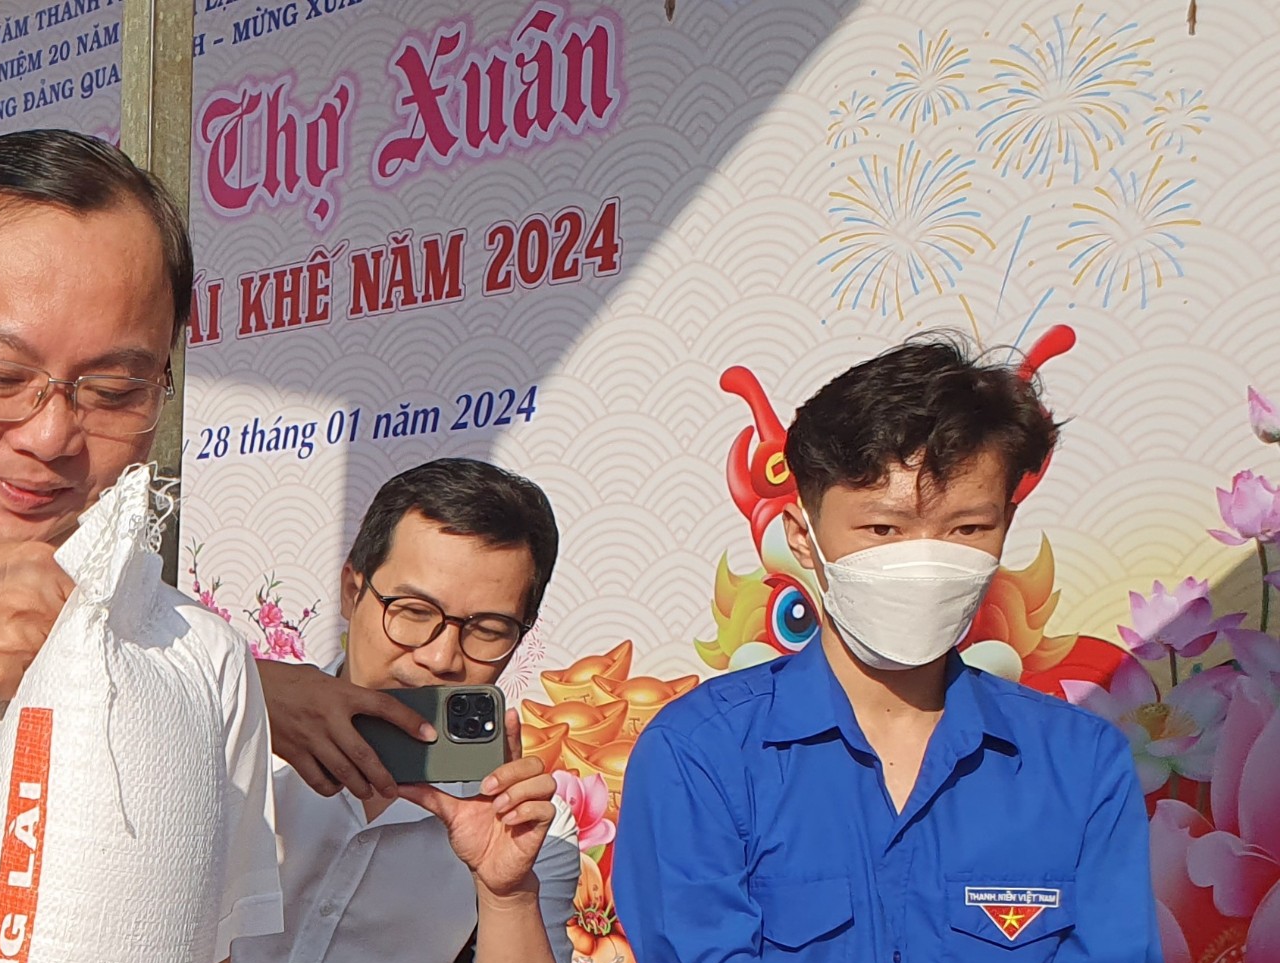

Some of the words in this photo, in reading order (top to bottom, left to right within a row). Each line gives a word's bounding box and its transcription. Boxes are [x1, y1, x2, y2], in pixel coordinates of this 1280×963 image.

[48, 41, 71, 66] 20
[76, 22, 120, 56] NĂM
[232, 3, 299, 45] MỪNG
[23, 78, 74, 113] ĐẢNG
[80, 62, 122, 99] QUA
[187, 273, 221, 344] ÁI
[239, 244, 346, 335] KHẾ
[349, 234, 464, 316] NĂM
[484, 203, 619, 297] 2024
[196, 427, 231, 460] 28
[239, 415, 317, 460] tháng
[326, 408, 360, 444] 01
[372, 401, 440, 440] năm
[450, 385, 537, 430] 2024
[7, 781, 42, 888] LÀI
